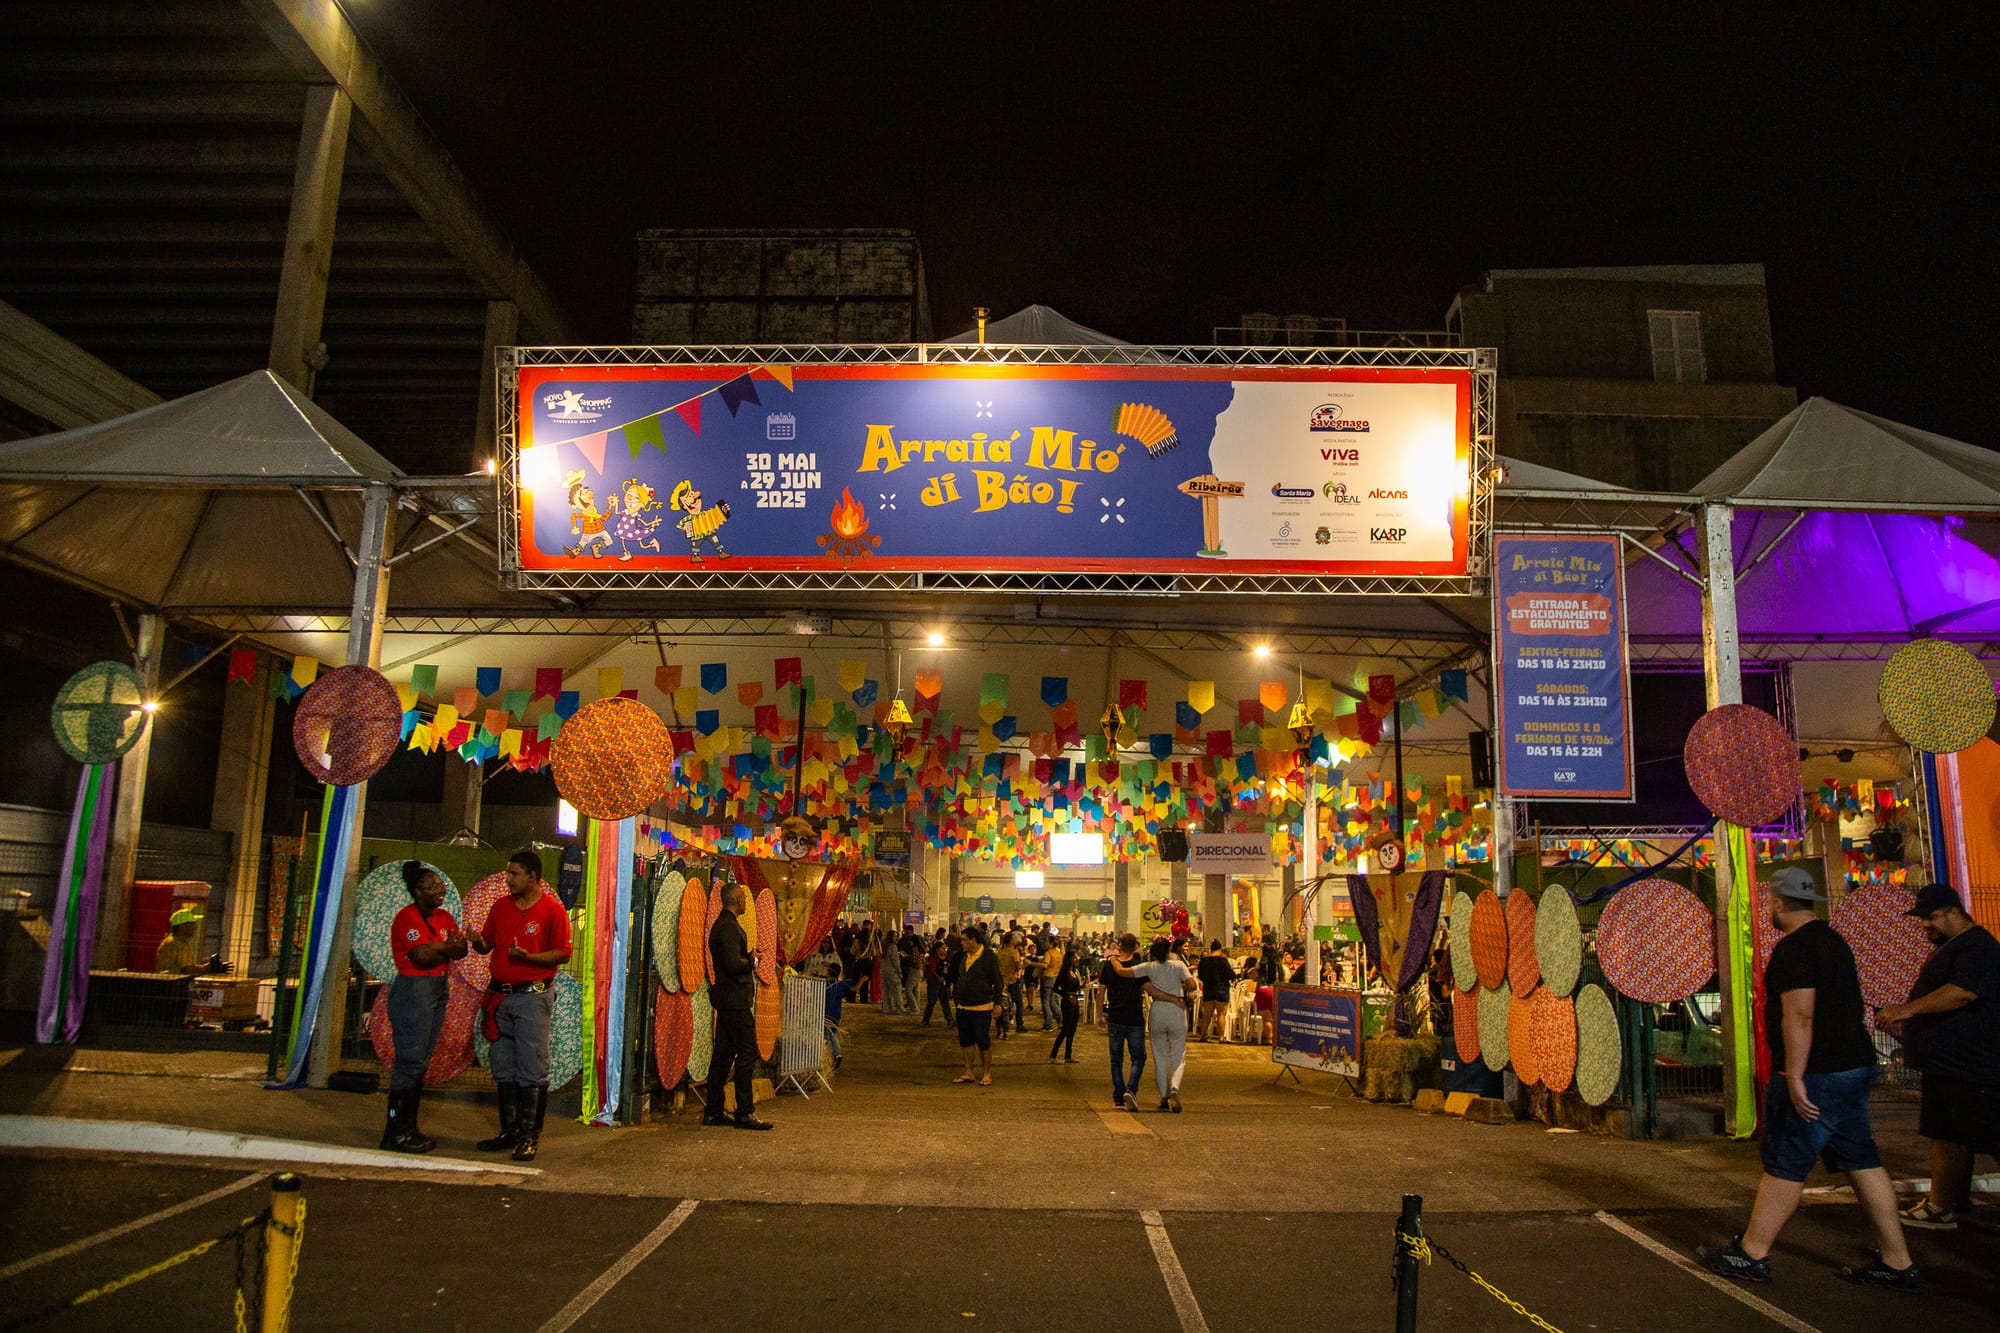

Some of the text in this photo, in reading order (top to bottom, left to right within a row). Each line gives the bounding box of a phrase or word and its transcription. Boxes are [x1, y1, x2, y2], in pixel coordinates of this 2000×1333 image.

[543, 393, 564, 404] NOVO
[580, 396, 613, 407] SHOPPING
[1310, 418, 1369, 430] Savegnago
[1320, 449, 1359, 461] viva
[746, 453, 816, 470] 30 MAI
[741, 472, 821, 489] A 29 JUN
[920, 469, 1084, 513] di Bão!
[1188, 481, 1242, 493] Ribeirão
[756, 490, 806, 508] 2025
[1334, 495, 1360, 503] IDEAL
[1534, 570, 1547, 583] di
[1529, 600, 1588, 609] ENTRADA E
[1511, 609, 1607, 620] ESTACIONAMENTO
[1530, 620, 1590, 630] GRATUITOS
[1520, 647, 1603, 657] SEXTAS-FEIRAS:
[1517, 658, 1606, 670] DAS 18 ÀS 23H30
[1536, 683, 1589, 694] SÁBADOS:
[1518, 694, 1607, 706] DAS 16 ÀS 23H30
[1524, 722, 1600, 733] DOMINGOS E O
[1515, 733, 1614, 745] FERIADO DE 19/06:
[1526, 745, 1603, 757] DAS 15 ÀS 22H
[1195, 846, 1267, 856] DIRECIONAL
